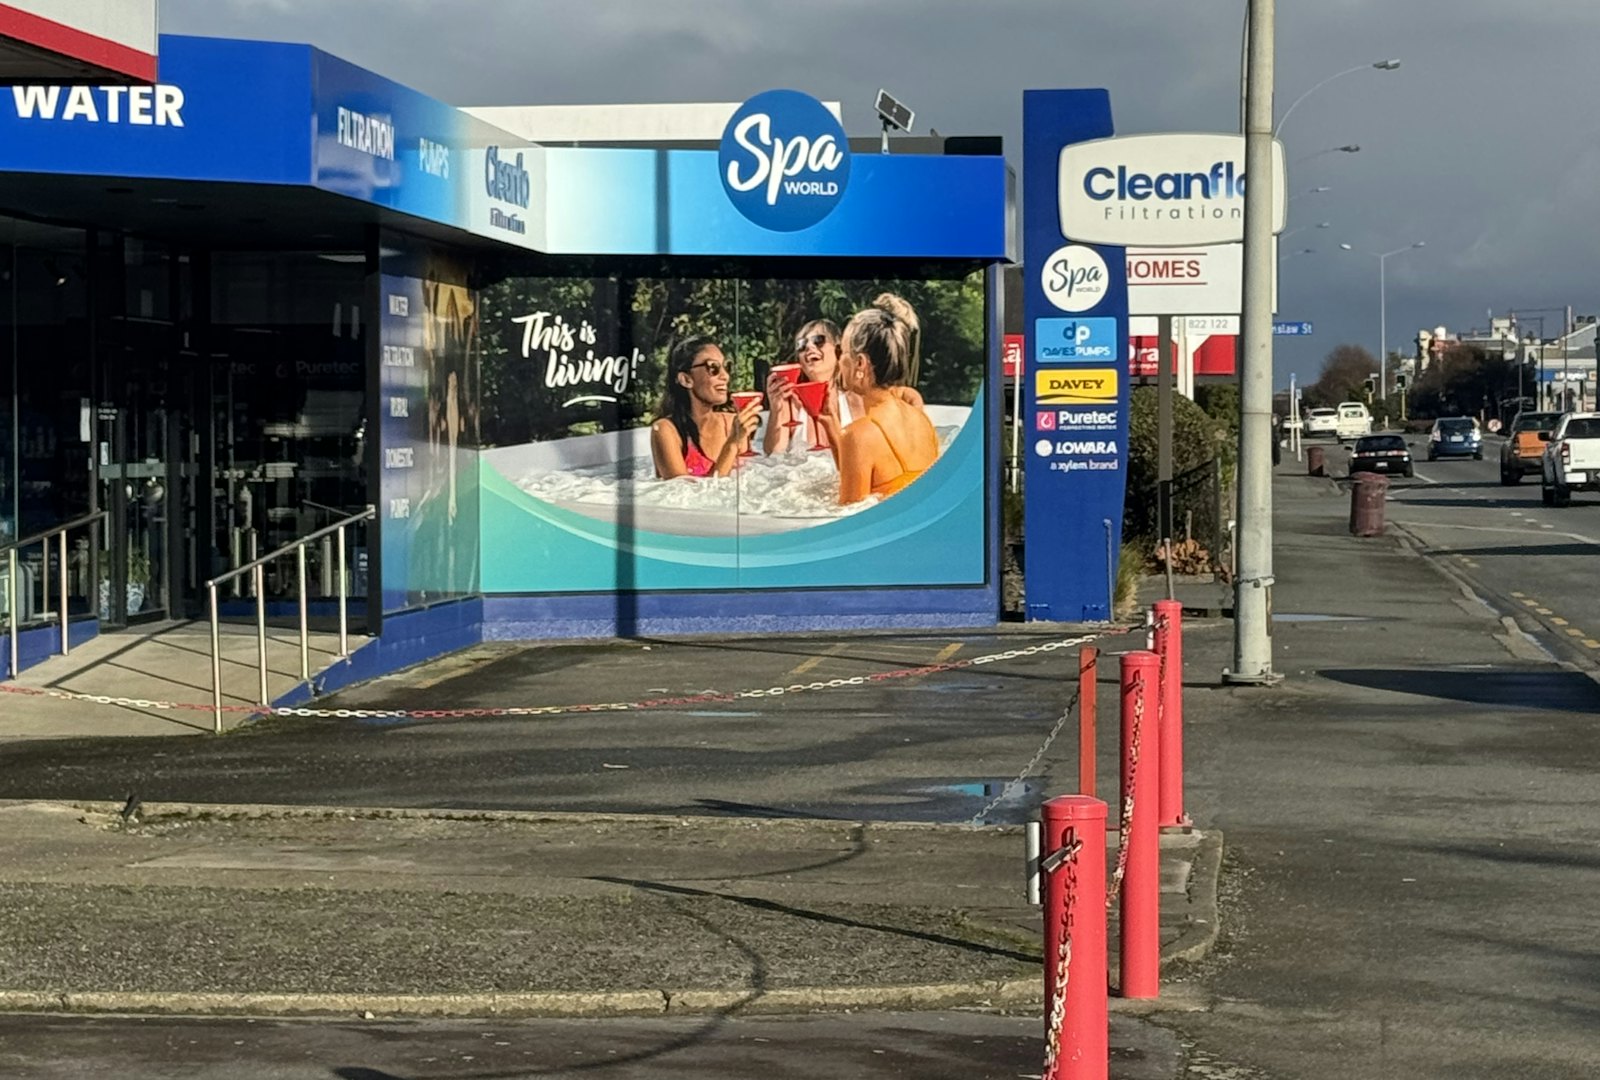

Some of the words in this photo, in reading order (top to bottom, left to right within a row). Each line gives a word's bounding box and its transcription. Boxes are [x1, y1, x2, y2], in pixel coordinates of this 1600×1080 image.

[12, 84, 185, 127] WATER
[337, 106, 395, 161] FILTRATION
[419, 137, 449, 180] PUMPS
[727, 113, 843, 206] Spa
[784, 181, 838, 196] WORLD
[1104, 204, 1241, 220] Filtration
[1049, 258, 1102, 298] Spa
[1188, 319, 1207, 329] 822
[1211, 319, 1229, 329] 122
[1302, 322, 1313, 335] St
[511, 311, 576, 358] This
[579, 320, 597, 345] is
[1049, 379, 1105, 390] DAVEY
[1058, 410, 1118, 425] Puretec
[1055, 441, 1118, 455] LOWARA
[1049, 461, 1058, 470] a
[1057, 459, 1089, 473] xylem
[1088, 459, 1119, 470] brand
